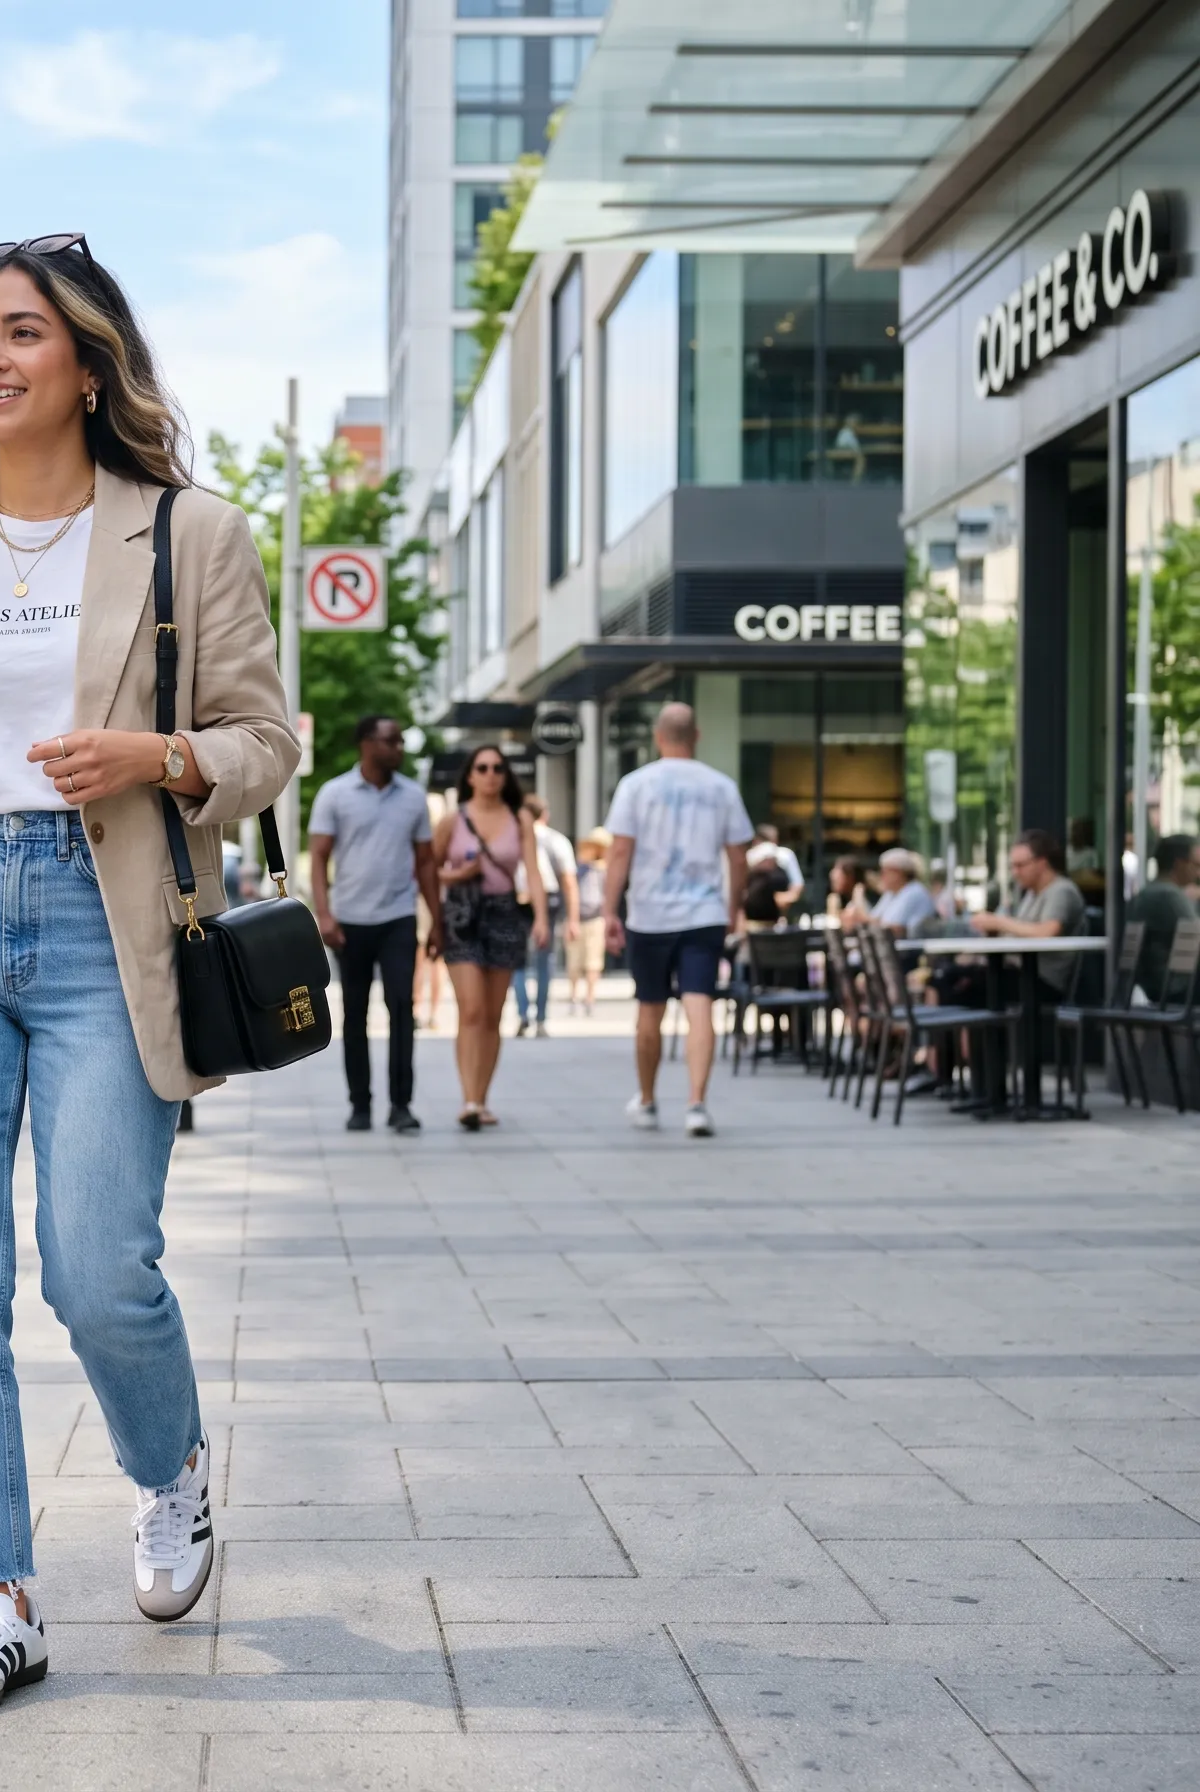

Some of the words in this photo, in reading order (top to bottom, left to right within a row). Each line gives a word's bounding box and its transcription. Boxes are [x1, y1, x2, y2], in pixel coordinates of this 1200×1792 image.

[973, 249, 1070, 399] COFFEE
[1074, 231, 1097, 331] &
[1102, 188, 1158, 309] CO.
[734, 604, 901, 642] COFFEE
